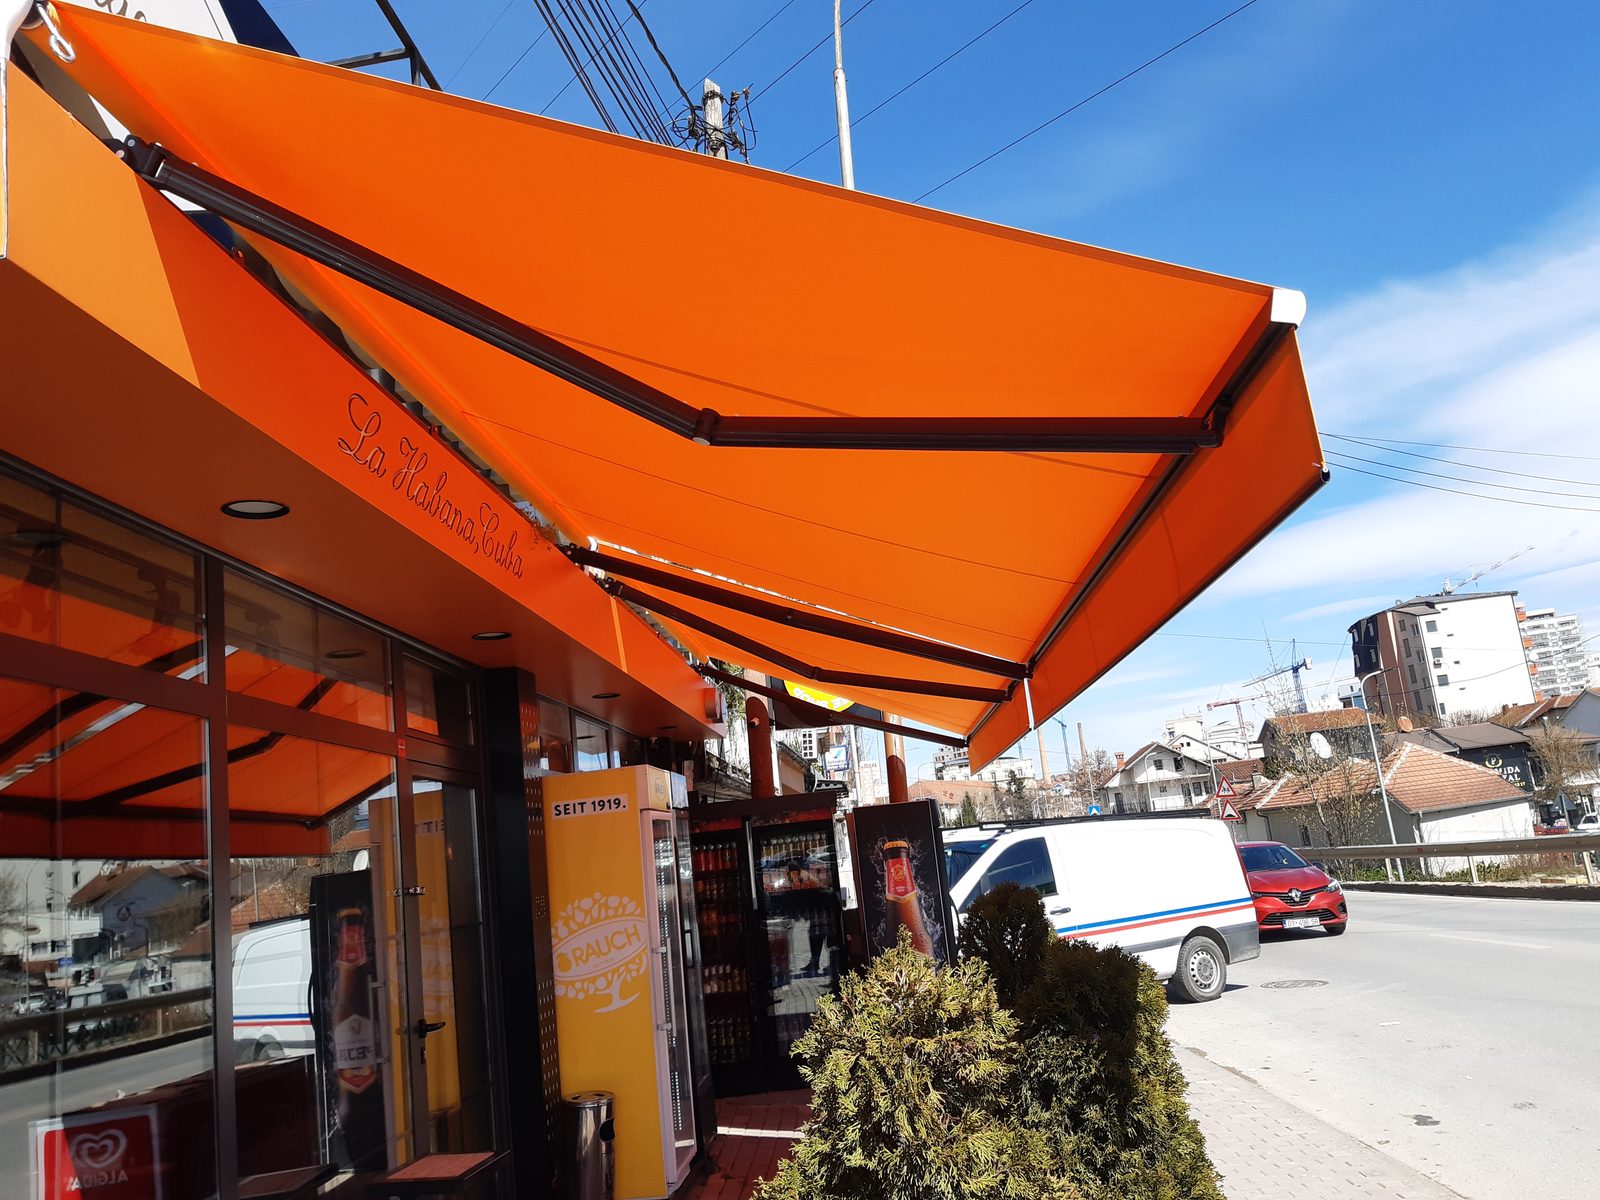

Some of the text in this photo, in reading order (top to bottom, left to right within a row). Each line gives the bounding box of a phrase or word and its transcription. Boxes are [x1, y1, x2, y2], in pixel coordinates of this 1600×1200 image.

[337, 392, 387, 478] La
[479, 502, 523, 579] Cuba
[554, 797, 626, 816] SEIT 1919.
[571, 923, 641, 967] RAUCH
